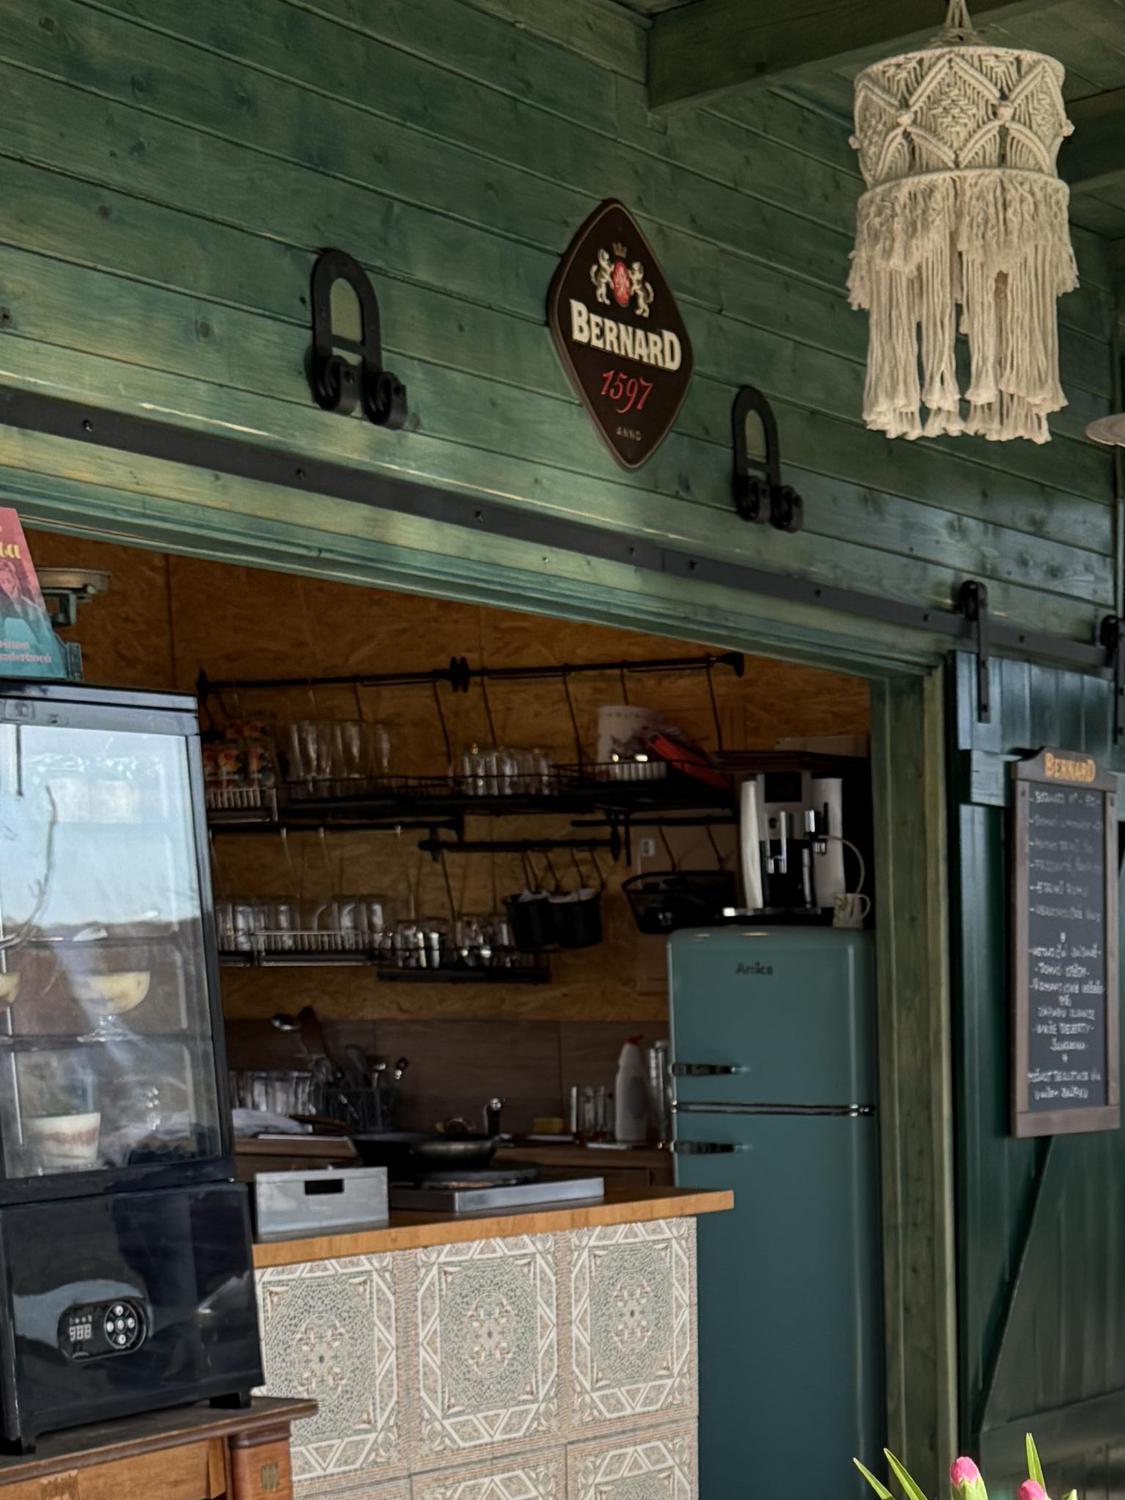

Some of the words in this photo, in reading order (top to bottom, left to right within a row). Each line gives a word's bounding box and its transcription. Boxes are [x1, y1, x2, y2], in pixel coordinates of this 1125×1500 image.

[569, 299, 682, 371] BERNARD
[600, 369, 653, 414] 1597
[1044, 752, 1096, 783] BERNARD
